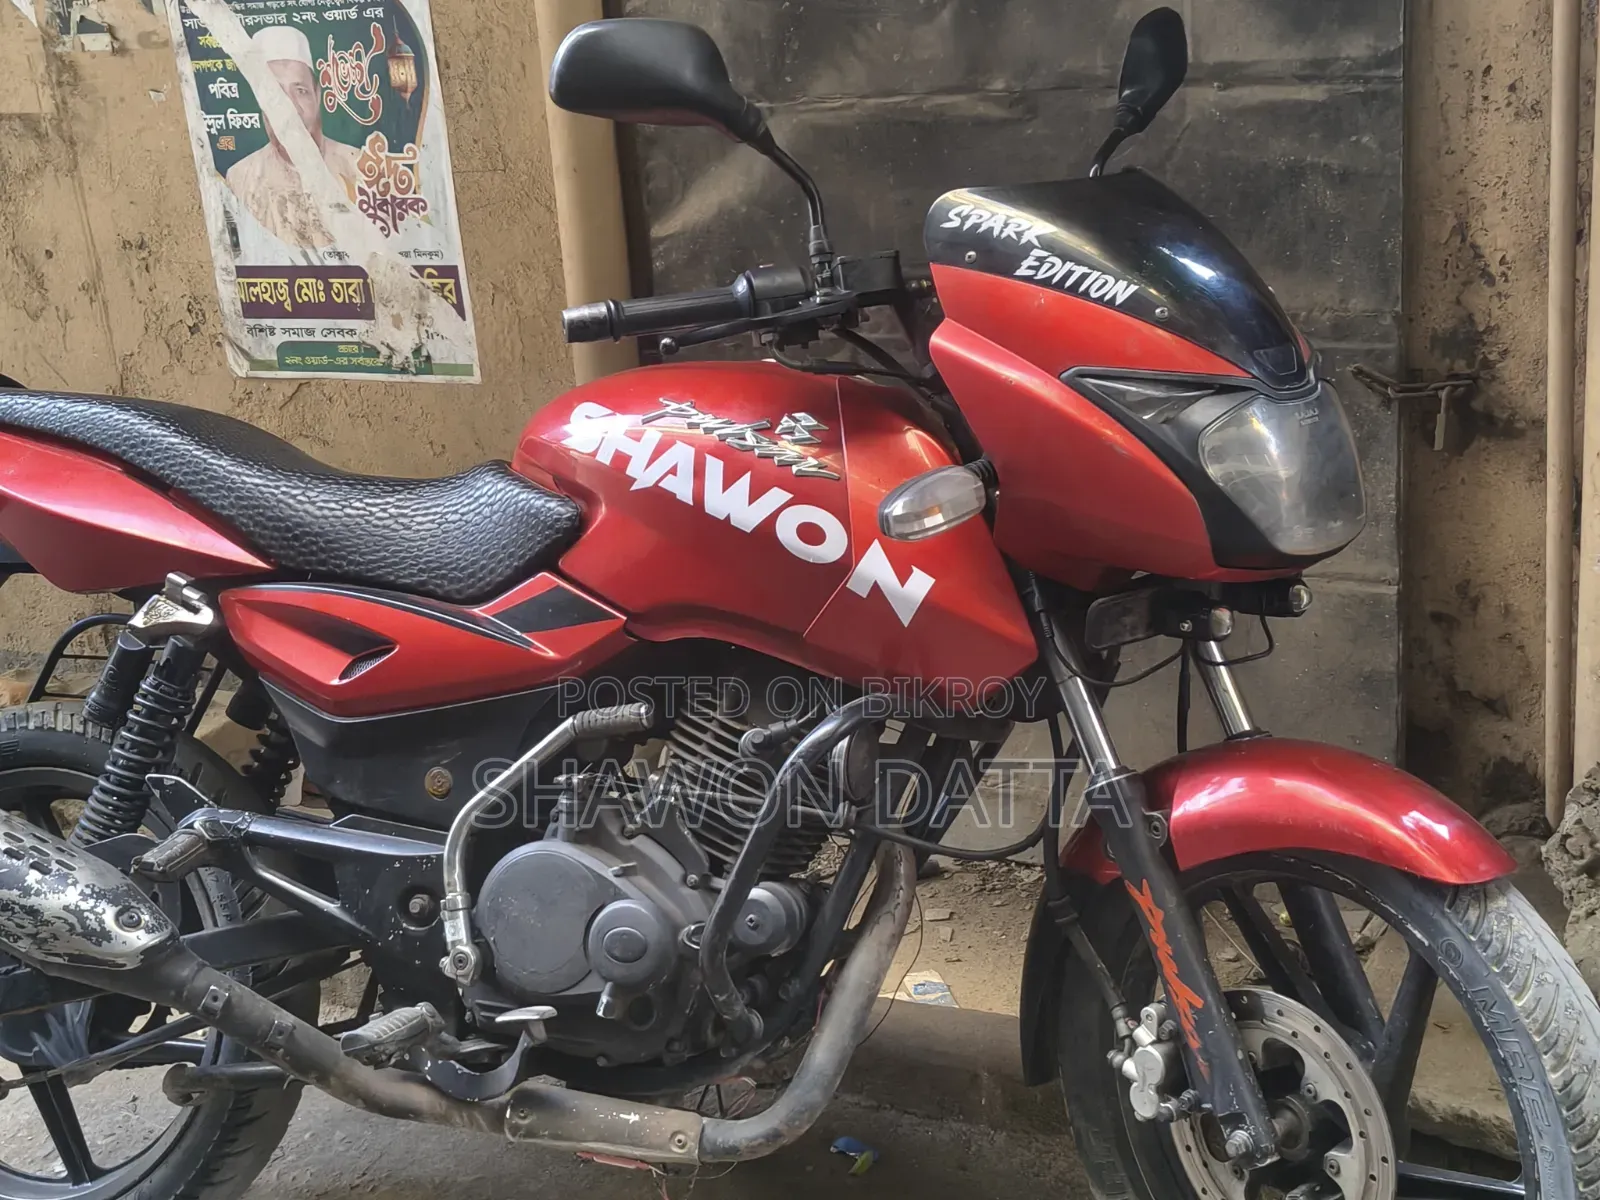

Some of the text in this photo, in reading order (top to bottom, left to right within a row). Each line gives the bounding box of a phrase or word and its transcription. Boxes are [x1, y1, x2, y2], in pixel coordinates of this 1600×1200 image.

[292, 11, 319, 24] ২নং
[322, 5, 358, 21] ওয়ার্ড
[363, 7, 384, 18] এর
[208, 77, 240, 99] পবিত্র
[226, 108, 261, 130] ফিতর
[357, 184, 429, 239] মুবারক
[940, 204, 1057, 247] SPARK
[1013, 248, 1139, 306] EDITION
[294, 278, 326, 304] মোঃ
[281, 326, 316, 338] সমাজ
[321, 327, 358, 339] সেবক
[561, 402, 936, 628] SHAWON
